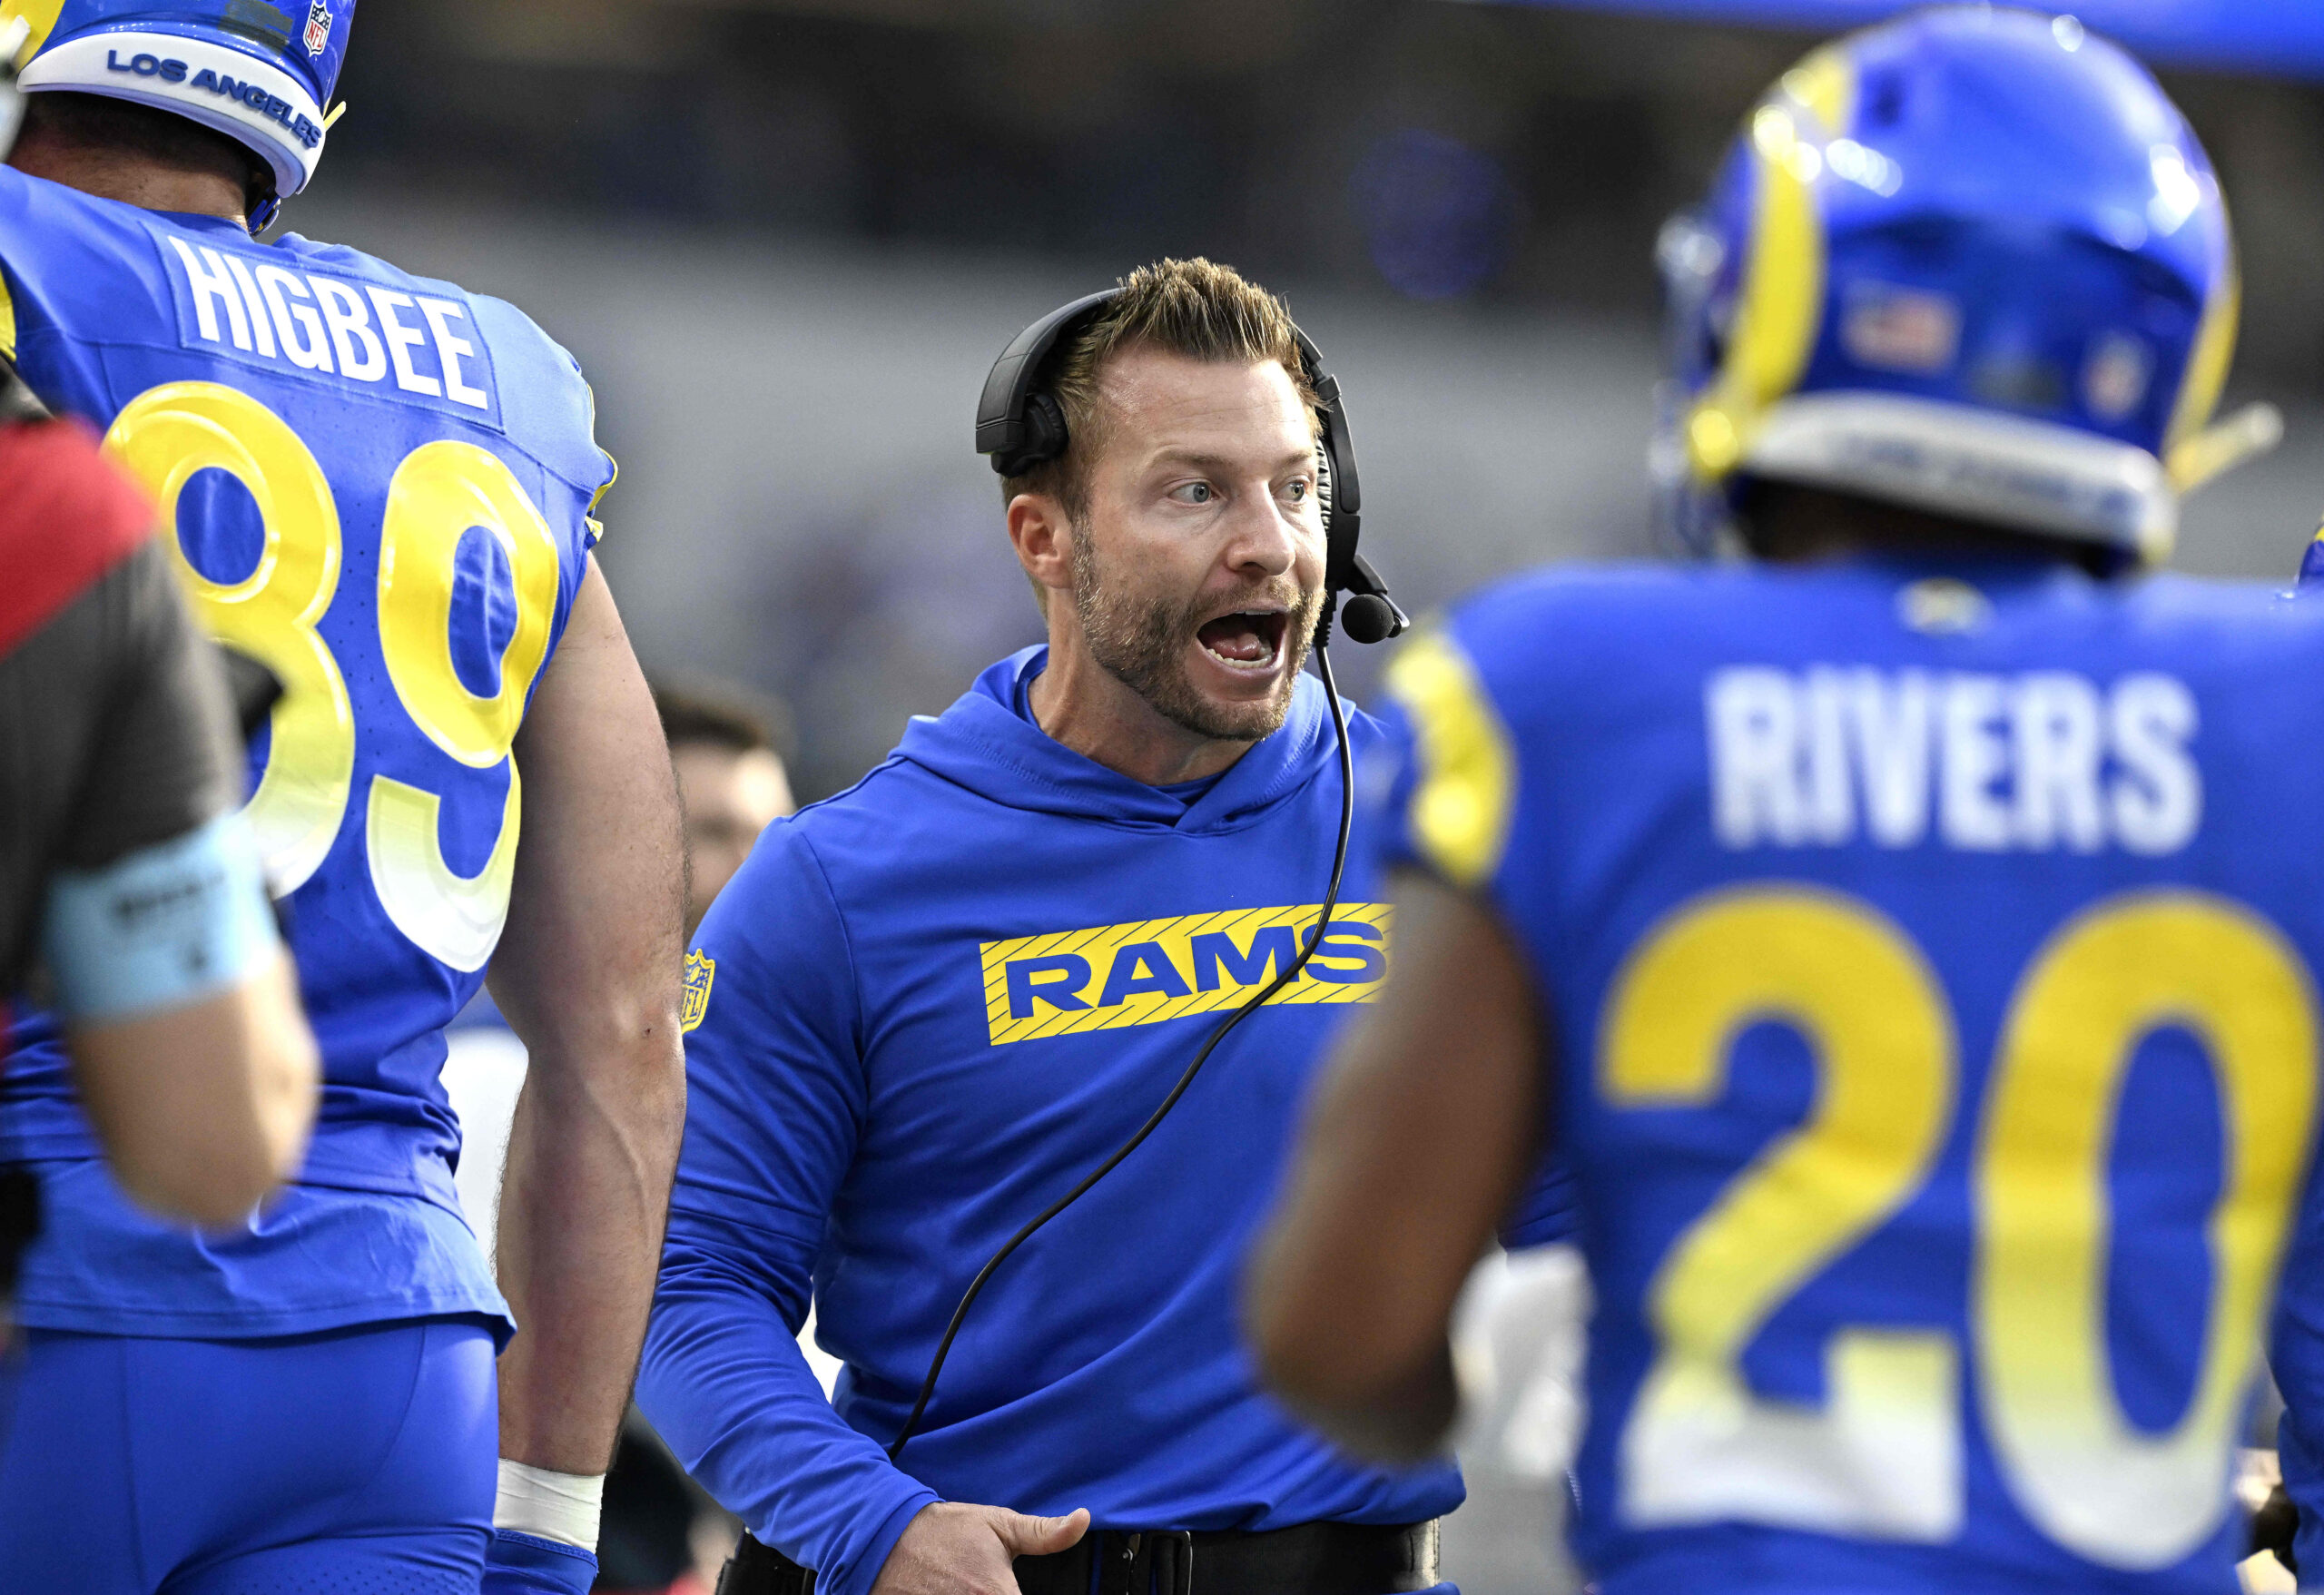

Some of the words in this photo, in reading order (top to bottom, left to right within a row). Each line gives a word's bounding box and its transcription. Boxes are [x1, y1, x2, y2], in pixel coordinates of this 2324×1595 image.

[107, 50, 188, 82] LOS
[191, 68, 321, 149] ANGELES
[307, 21, 324, 48] NFL
[168, 234, 487, 409] HIGBEE
[101, 381, 559, 973] 89
[1708, 667, 2201, 852] RIVERS
[1005, 921, 1386, 1020] RAMS
[1602, 882, 2319, 1570] 20
